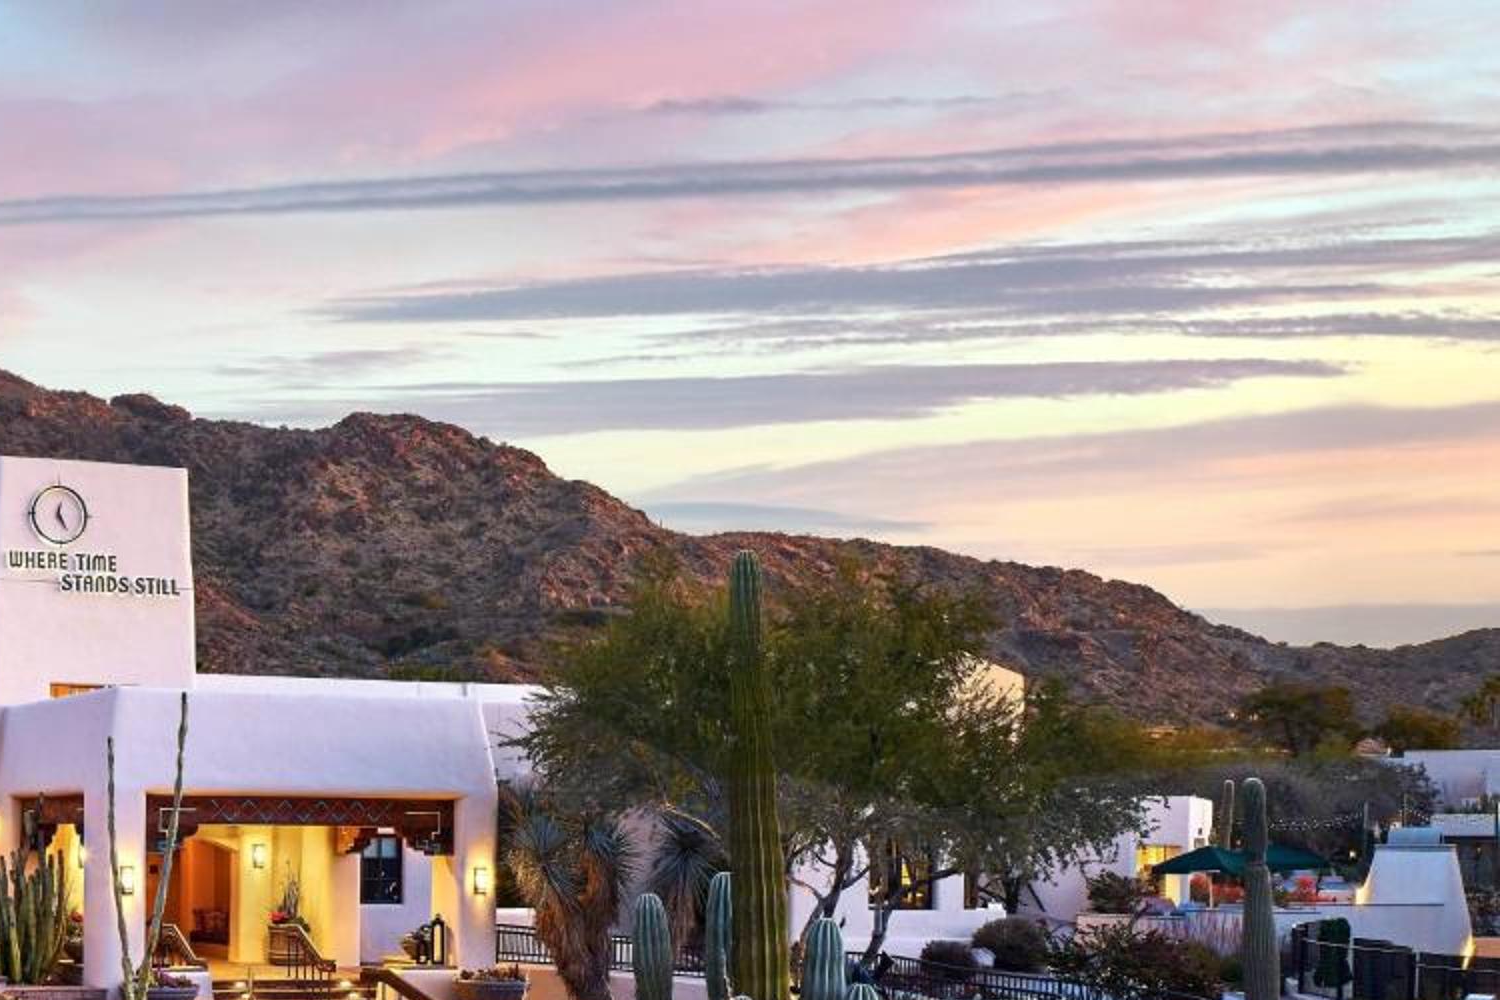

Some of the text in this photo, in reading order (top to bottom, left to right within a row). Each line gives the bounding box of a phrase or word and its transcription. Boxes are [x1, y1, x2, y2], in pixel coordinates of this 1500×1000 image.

[9, 550, 117, 573] WHERE TIME
[61, 573, 180, 596] STANDS STILL
